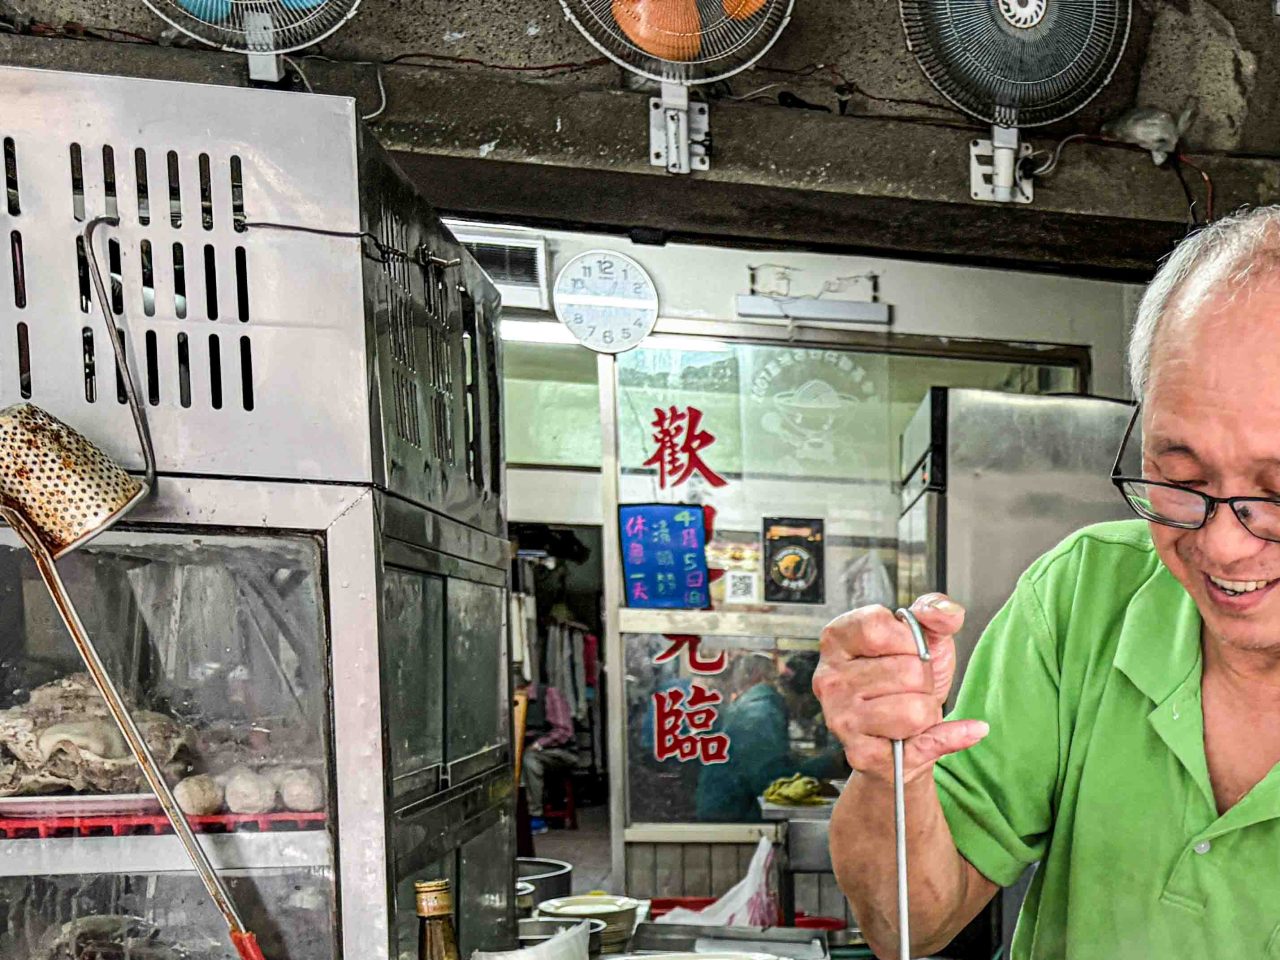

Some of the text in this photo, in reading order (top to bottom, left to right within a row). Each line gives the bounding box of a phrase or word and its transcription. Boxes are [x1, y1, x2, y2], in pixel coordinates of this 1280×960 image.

[582, 265, 592, 278] 11
[597, 259, 614, 275] 12
[622, 268, 628, 281] 1
[573, 312, 583, 325] 8
[633, 318, 643, 329] 4
[587, 325, 597, 337] 7
[602, 329, 614, 345] 6
[622, 327, 632, 340] 5
